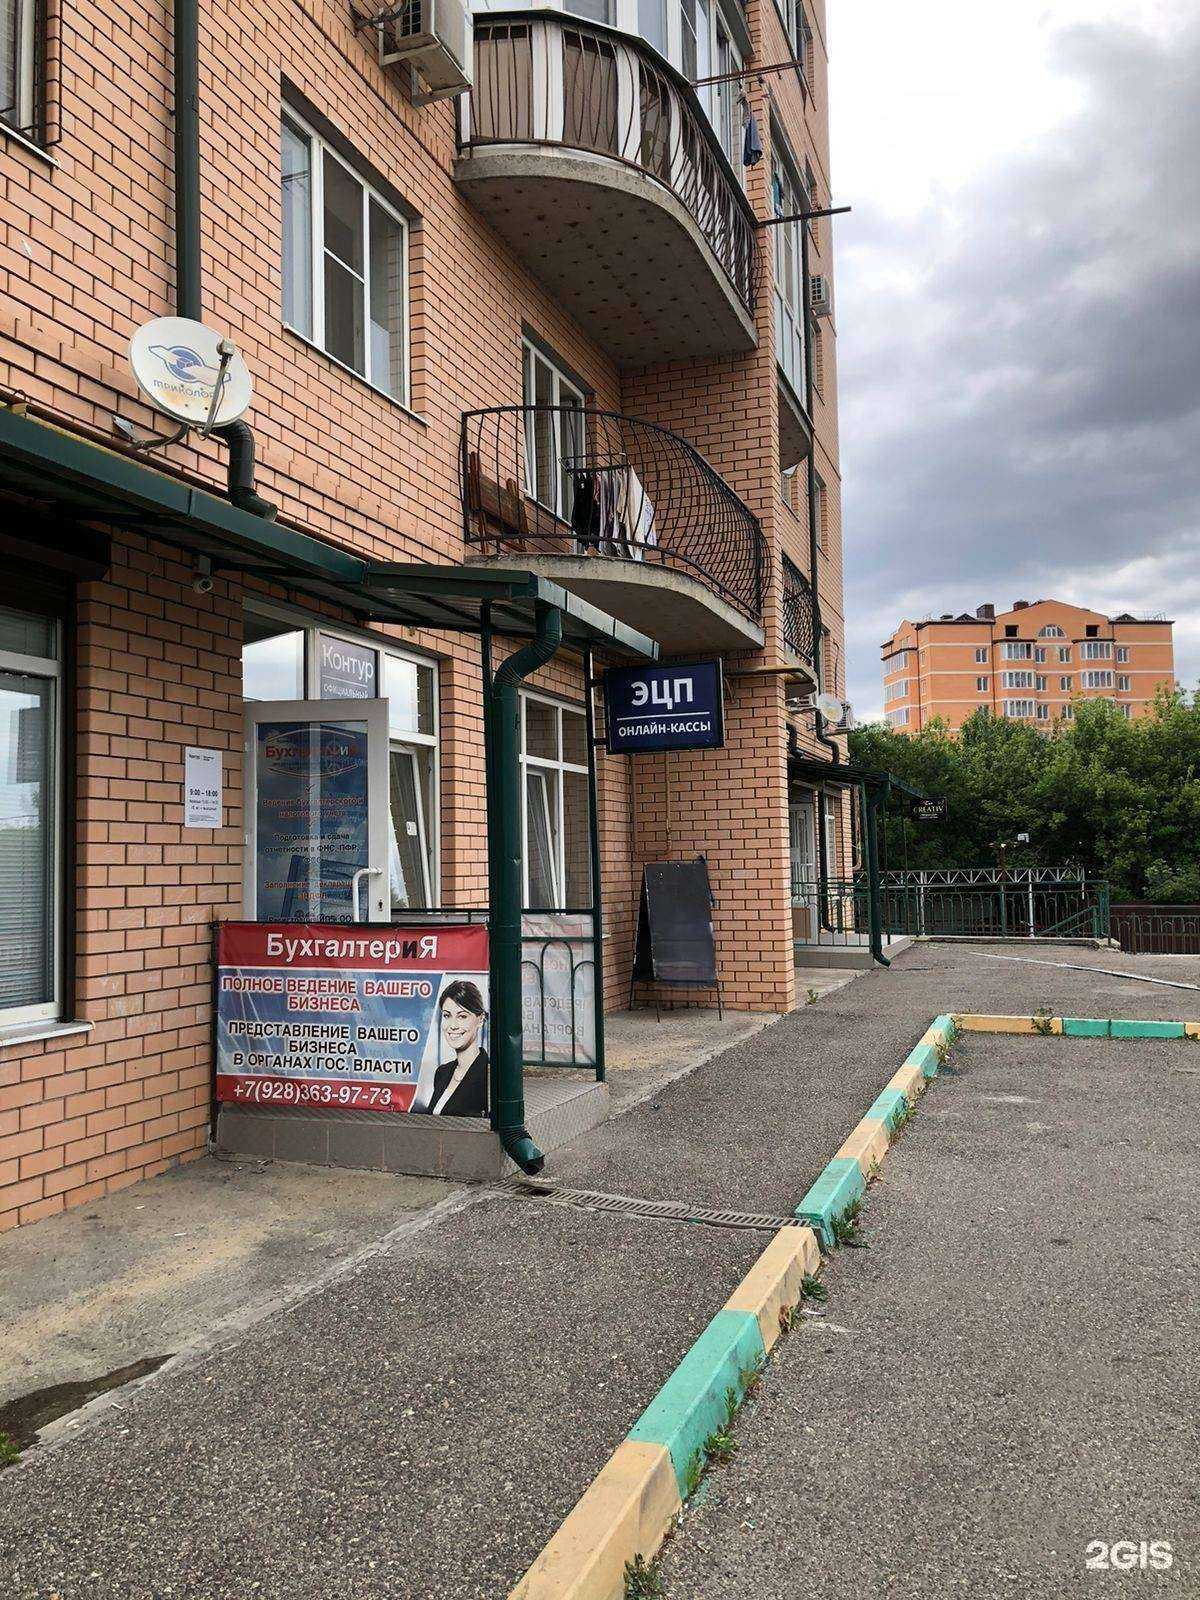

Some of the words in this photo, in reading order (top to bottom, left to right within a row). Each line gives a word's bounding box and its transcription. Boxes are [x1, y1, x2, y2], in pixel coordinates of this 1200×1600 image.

[322, 644, 374, 683] Контур
[630, 677, 694, 710] ЭЦП
[618, 720, 711, 737] ОНЛАЙН-КАССЫ
[273, 833, 318, 842] Подготовка
[327, 832, 350, 842] сдача
[266, 933, 438, 964] БухгалтериЯ
[222, 976, 282, 992] ПОЛНОЕ
[286, 978, 356, 996] ВЕДЕНИЕ
[364, 981, 432, 997] ВАШЕГО
[288, 996, 361, 1012] БИЗНЕСА
[228, 1021, 349, 1039] ПРЕДСТАВЛЕНИЕ
[357, 1027, 419, 1043] ВАШЕГО
[289, 1041, 358, 1055] БИЗНЕСА
[233, 1054, 243, 1066] В
[247, 1055, 312, 1070] ОРГАНАХ
[316, 1059, 349, 1071] ГОС.
[353, 1061, 412, 1074] ВЛАСТИ
[233, 1081, 392, 1105] +7(928)363-97-73
